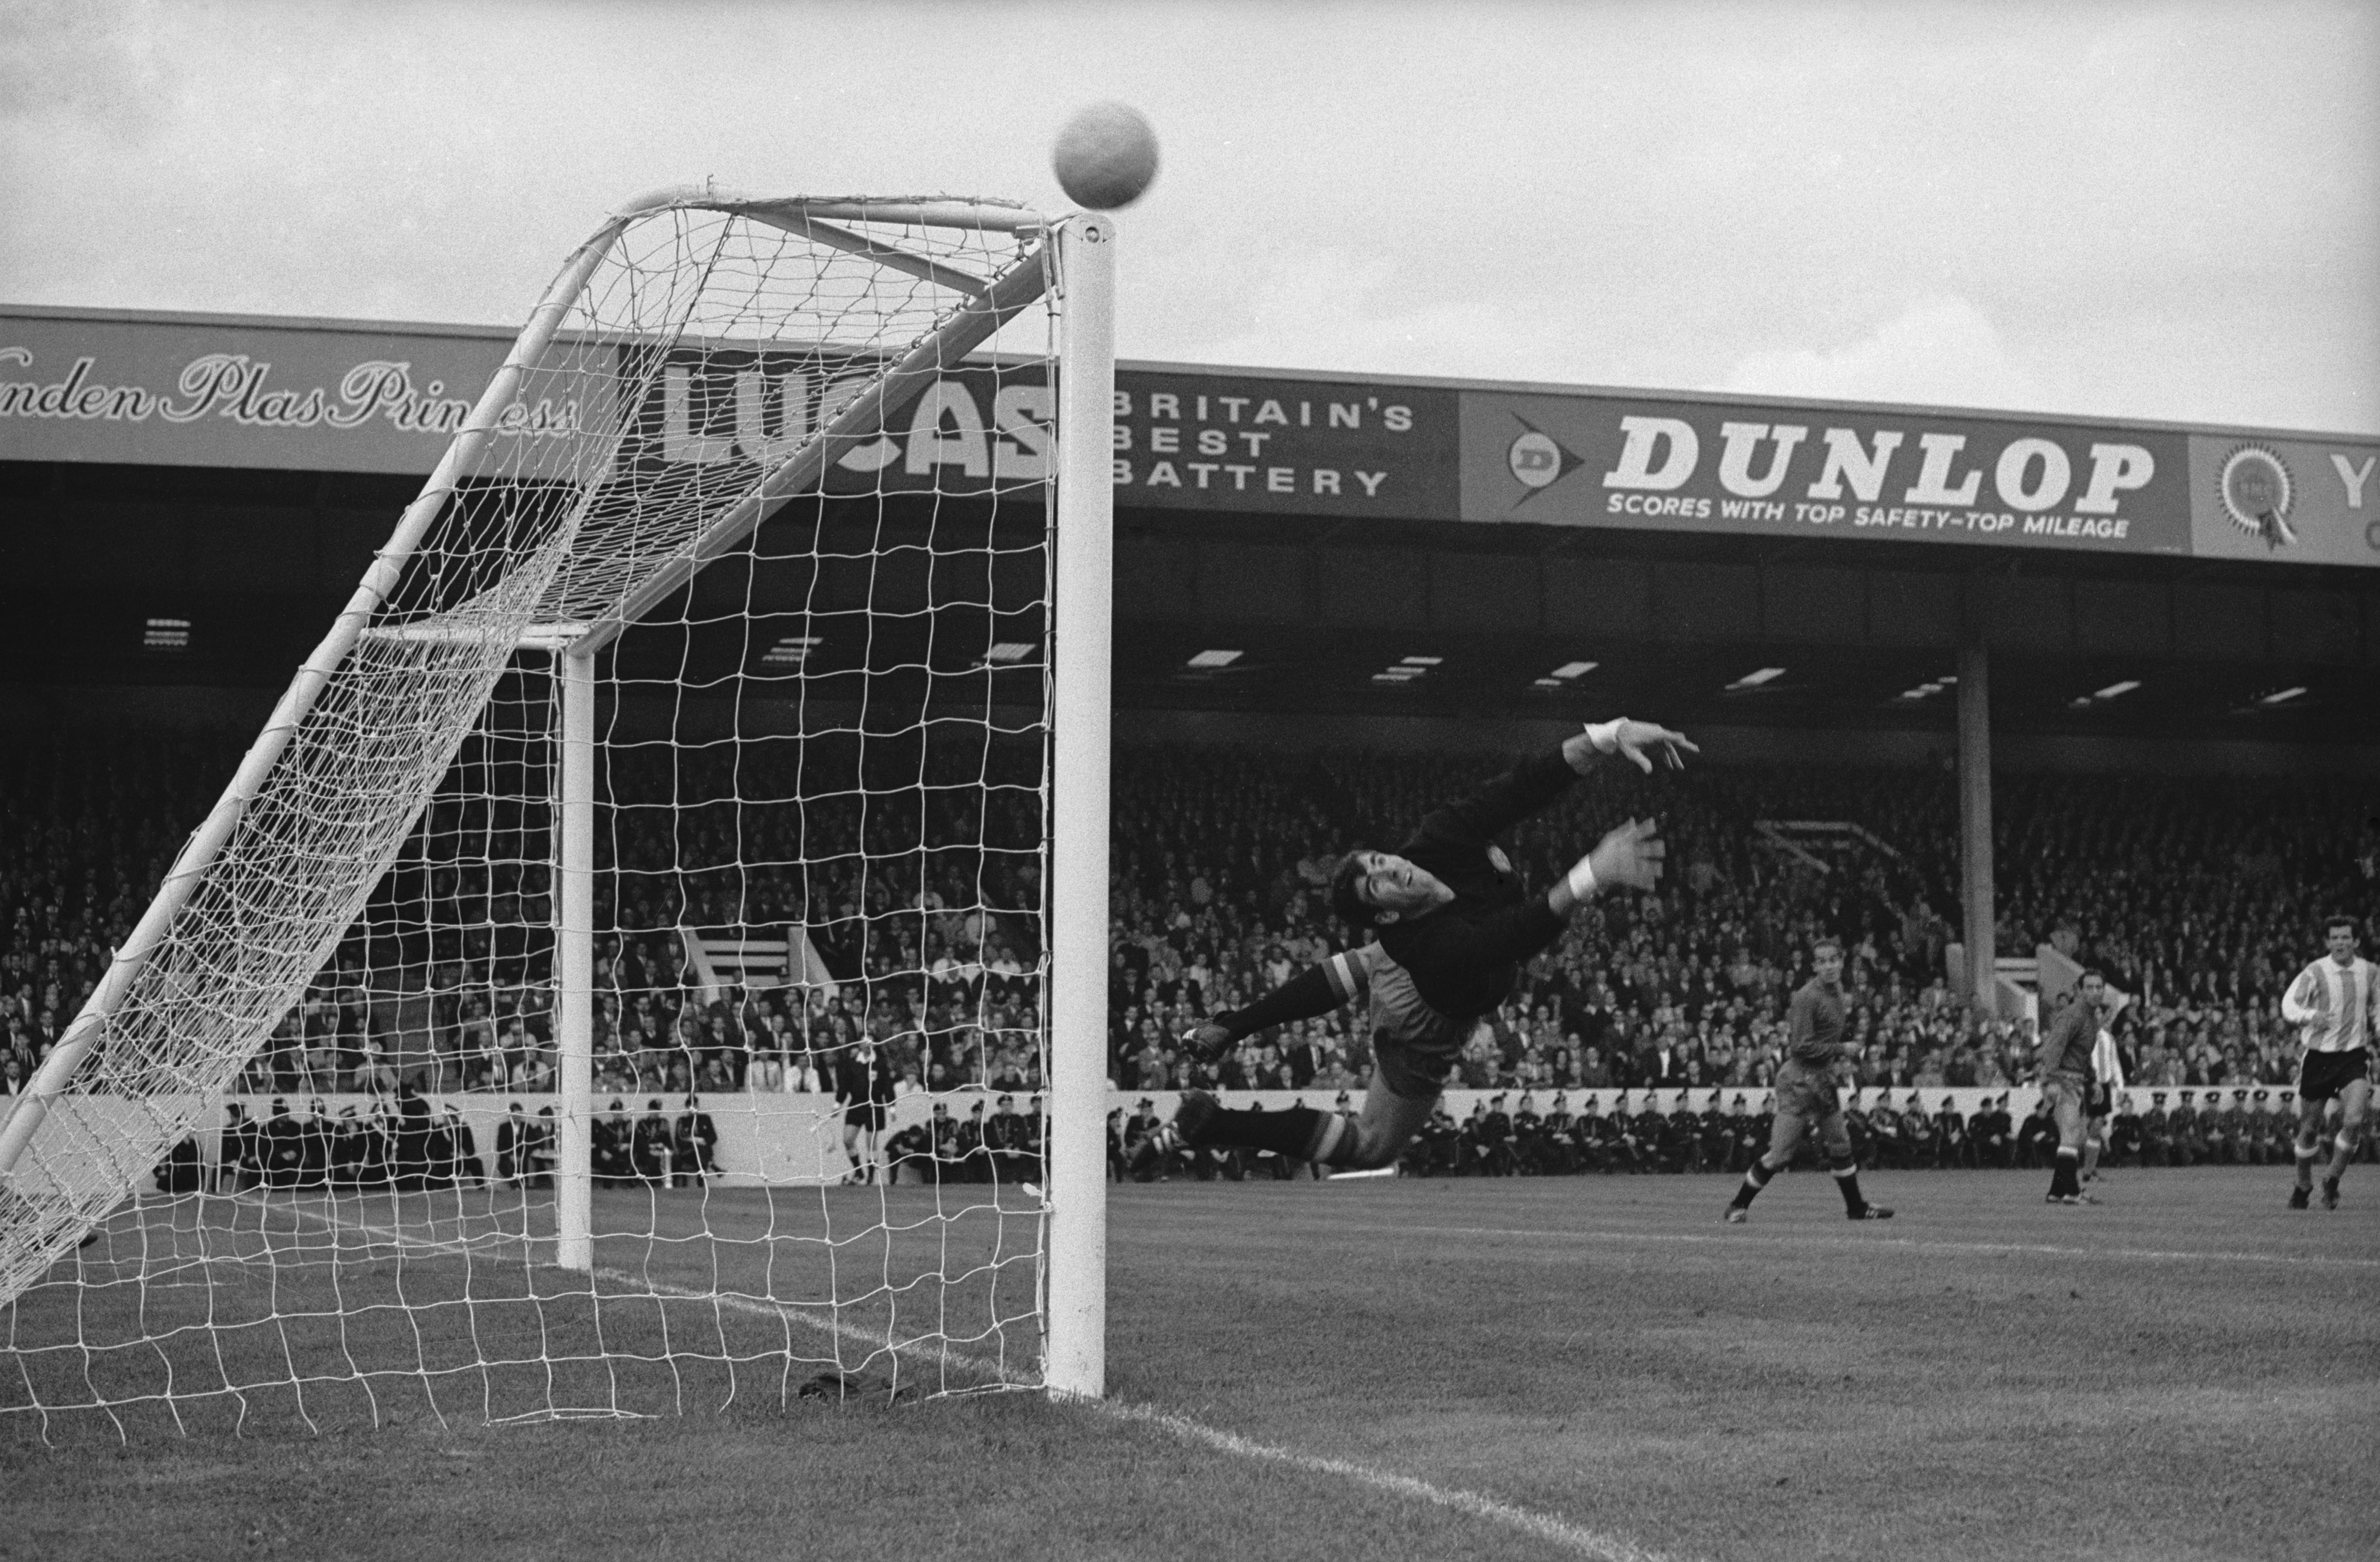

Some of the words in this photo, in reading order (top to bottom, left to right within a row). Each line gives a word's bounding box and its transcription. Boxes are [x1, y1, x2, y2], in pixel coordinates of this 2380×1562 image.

[0, 346, 157, 421] nden
[158, 353, 326, 427] Plas
[324, 360, 579, 438] Priness
[1114, 391, 1413, 431] BRITAIN'S
[1114, 425, 1270, 457] BEST
[1114, 459, 1388, 496] BATTERY
[1602, 415, 2155, 514] DUNLOP
[1606, 493, 1712, 519] SCORES
[1720, 500, 1786, 521] WITH
[1795, 503, 1846, 523] TOP
[2022, 514, 2129, 539] MILEAGE
